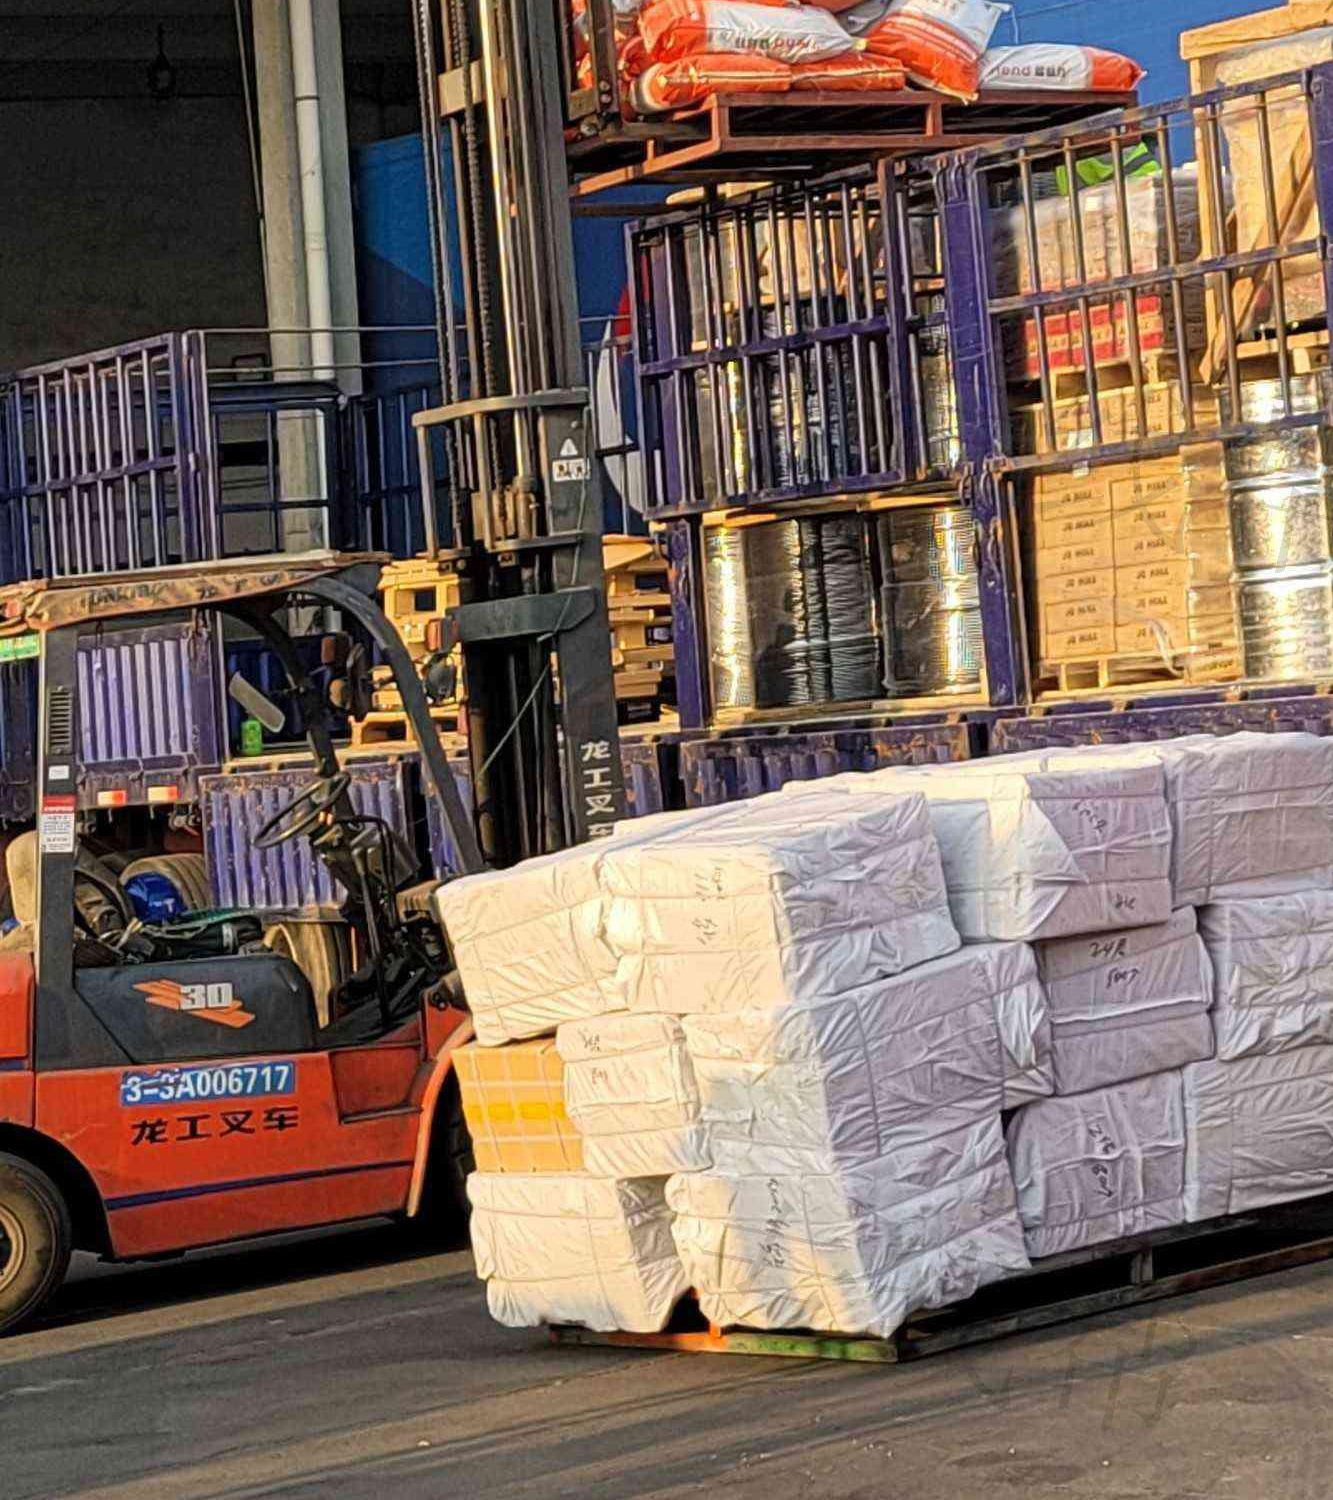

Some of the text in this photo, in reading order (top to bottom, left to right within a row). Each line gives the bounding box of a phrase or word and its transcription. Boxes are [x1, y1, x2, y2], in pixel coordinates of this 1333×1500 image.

[180, 982, 233, 1011] 30
[131, 1106, 299, 1146] 龙工叉车
